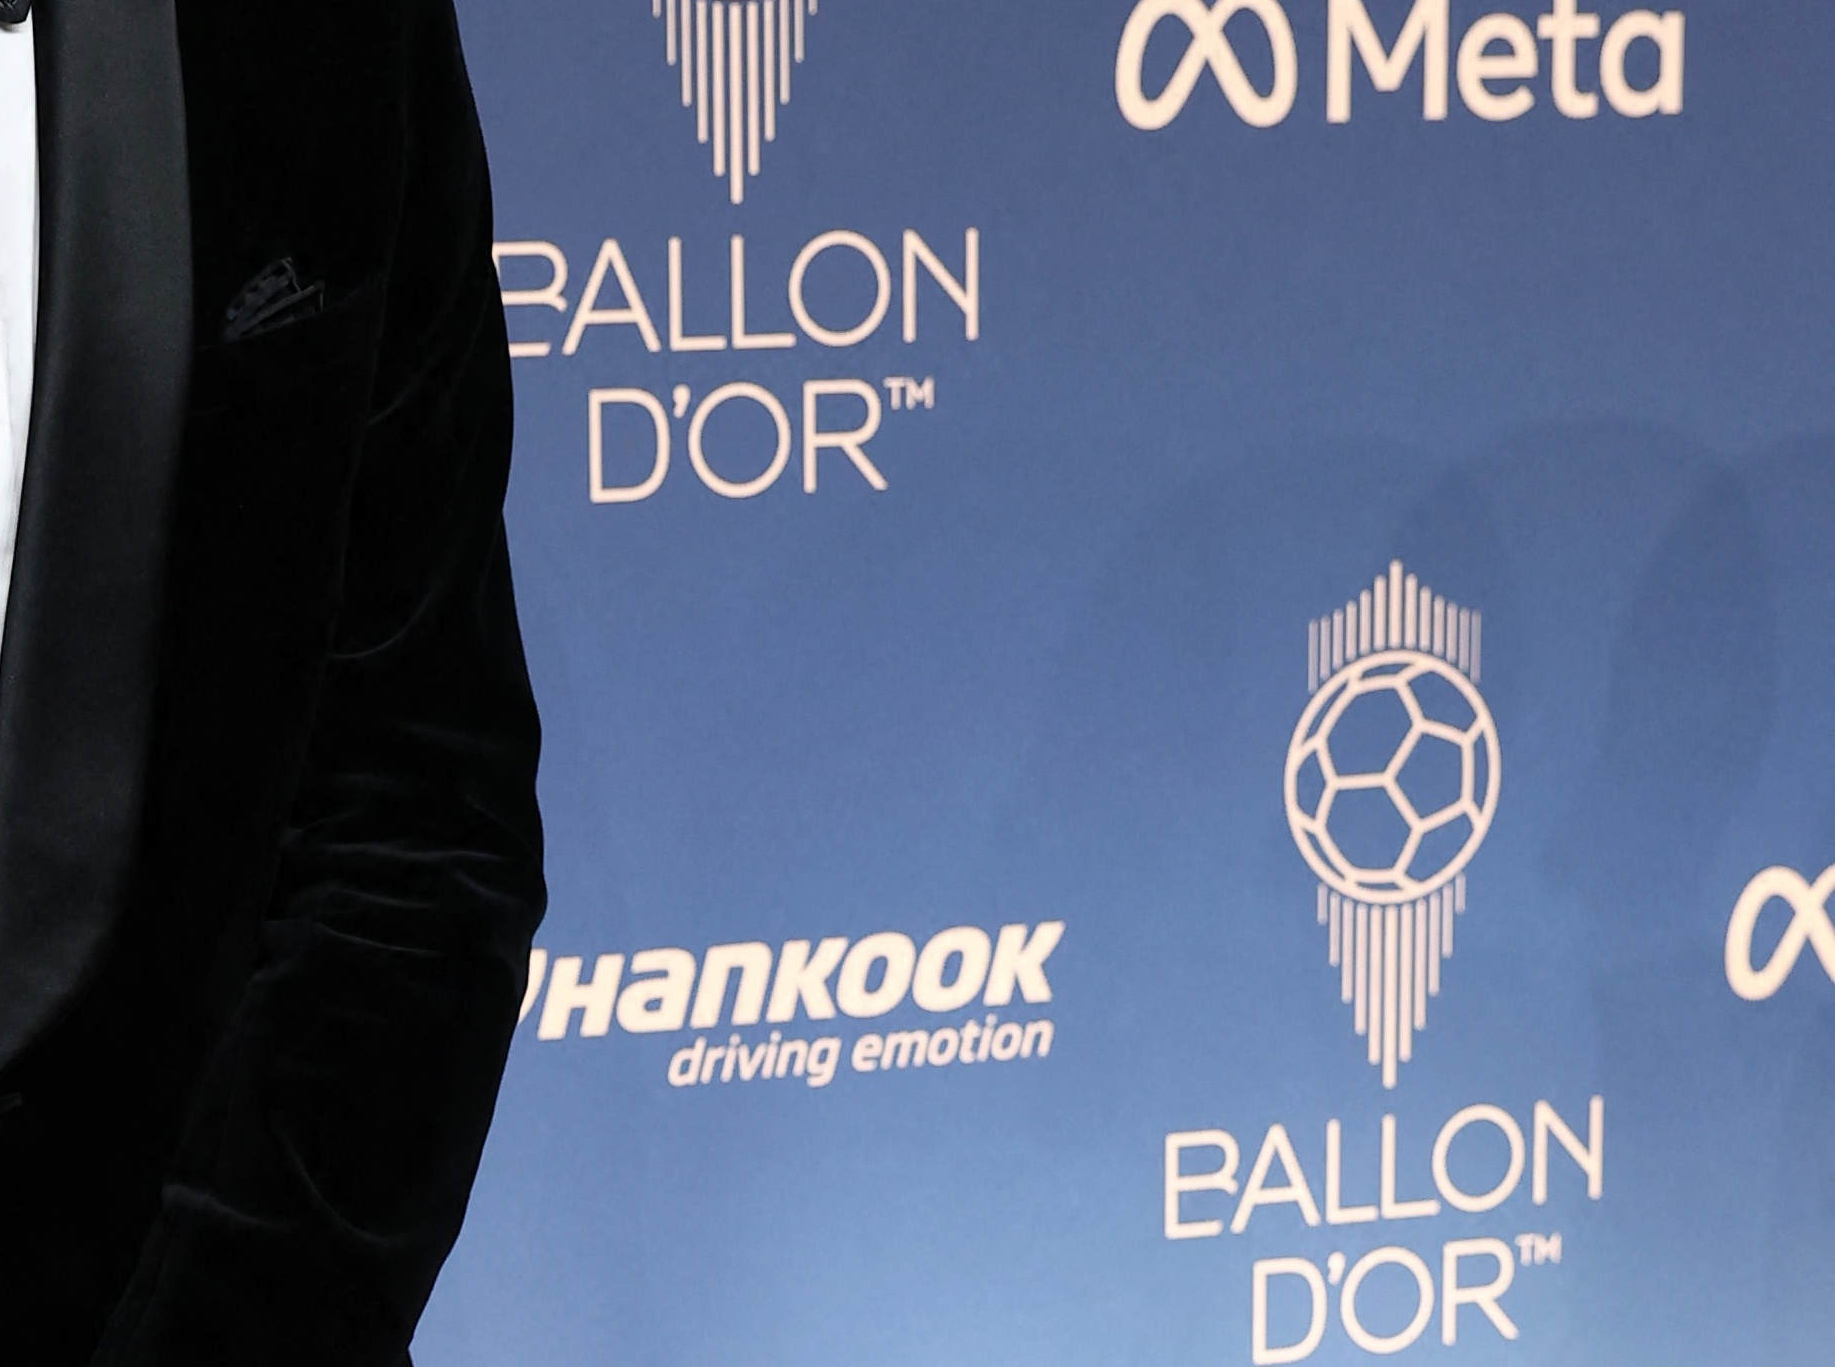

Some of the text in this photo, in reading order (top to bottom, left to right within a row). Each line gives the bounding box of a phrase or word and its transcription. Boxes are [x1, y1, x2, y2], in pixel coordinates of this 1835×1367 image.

[491, 226, 980, 359] BALLON
[667, 1014, 1054, 1088] driving emotion
[1164, 1095, 1604, 1240] BALLON
